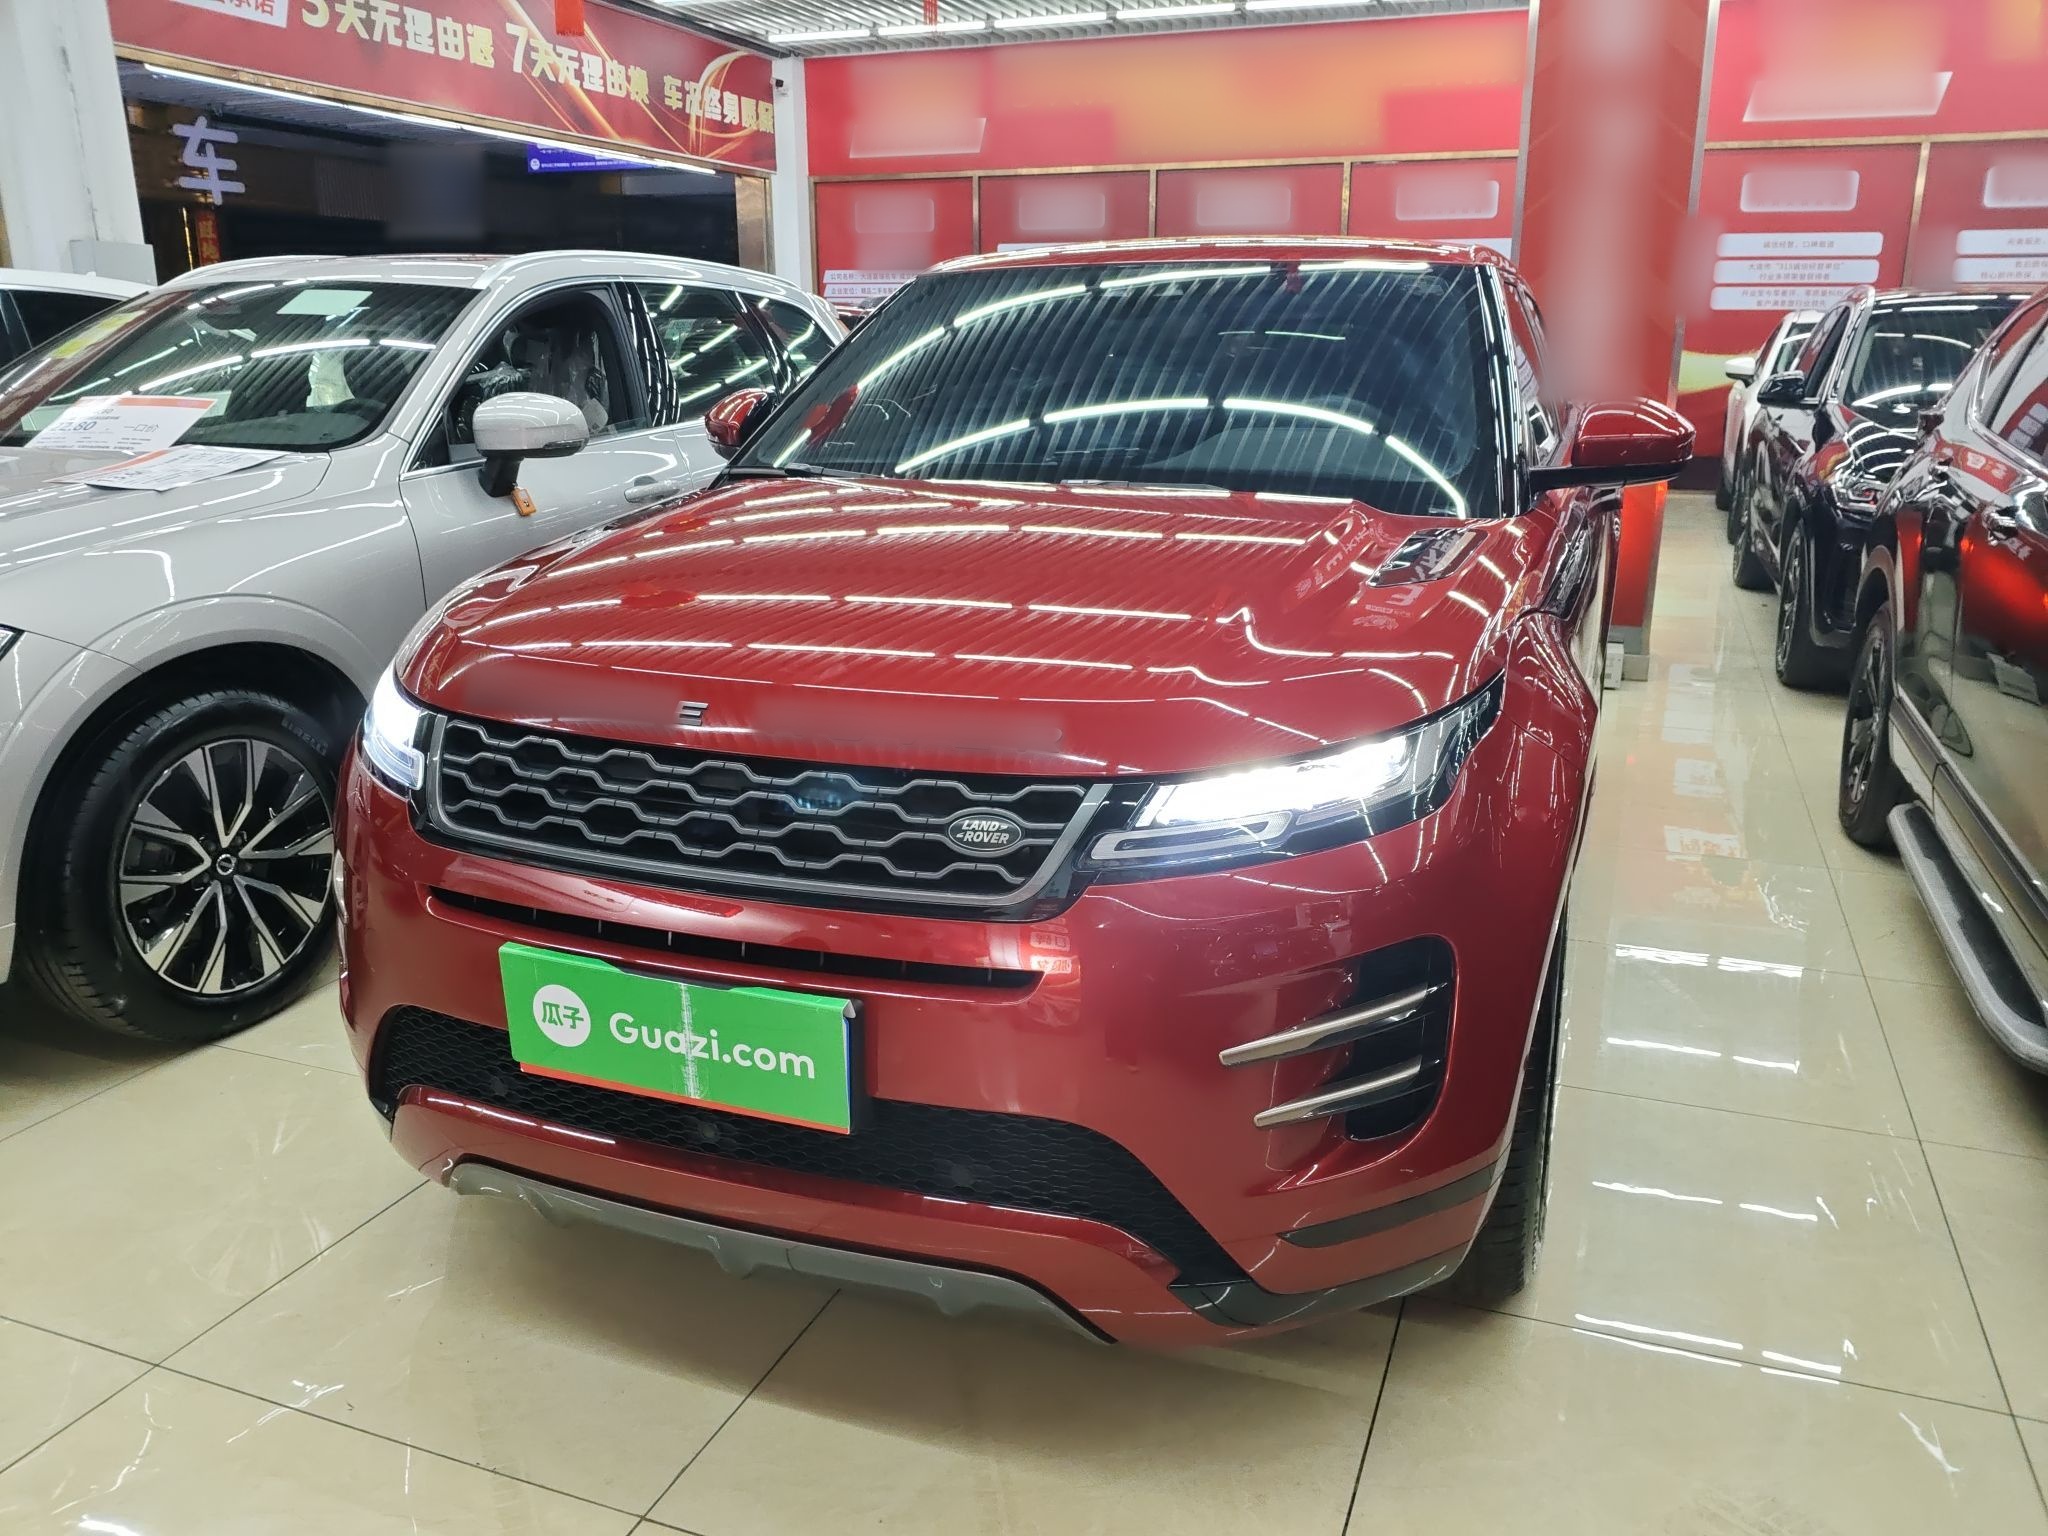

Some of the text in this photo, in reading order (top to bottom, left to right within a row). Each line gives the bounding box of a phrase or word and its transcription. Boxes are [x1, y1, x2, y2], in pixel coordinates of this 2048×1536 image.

[172, 115, 246, 206] 车
[123, 423, 160, 433] 一口价
[961, 820, 1001, 832] LAND
[963, 830, 1010, 844] ROVER
[541, 1000, 585, 1031] 瓜子
[608, 1011, 816, 1080] Guazi.com
